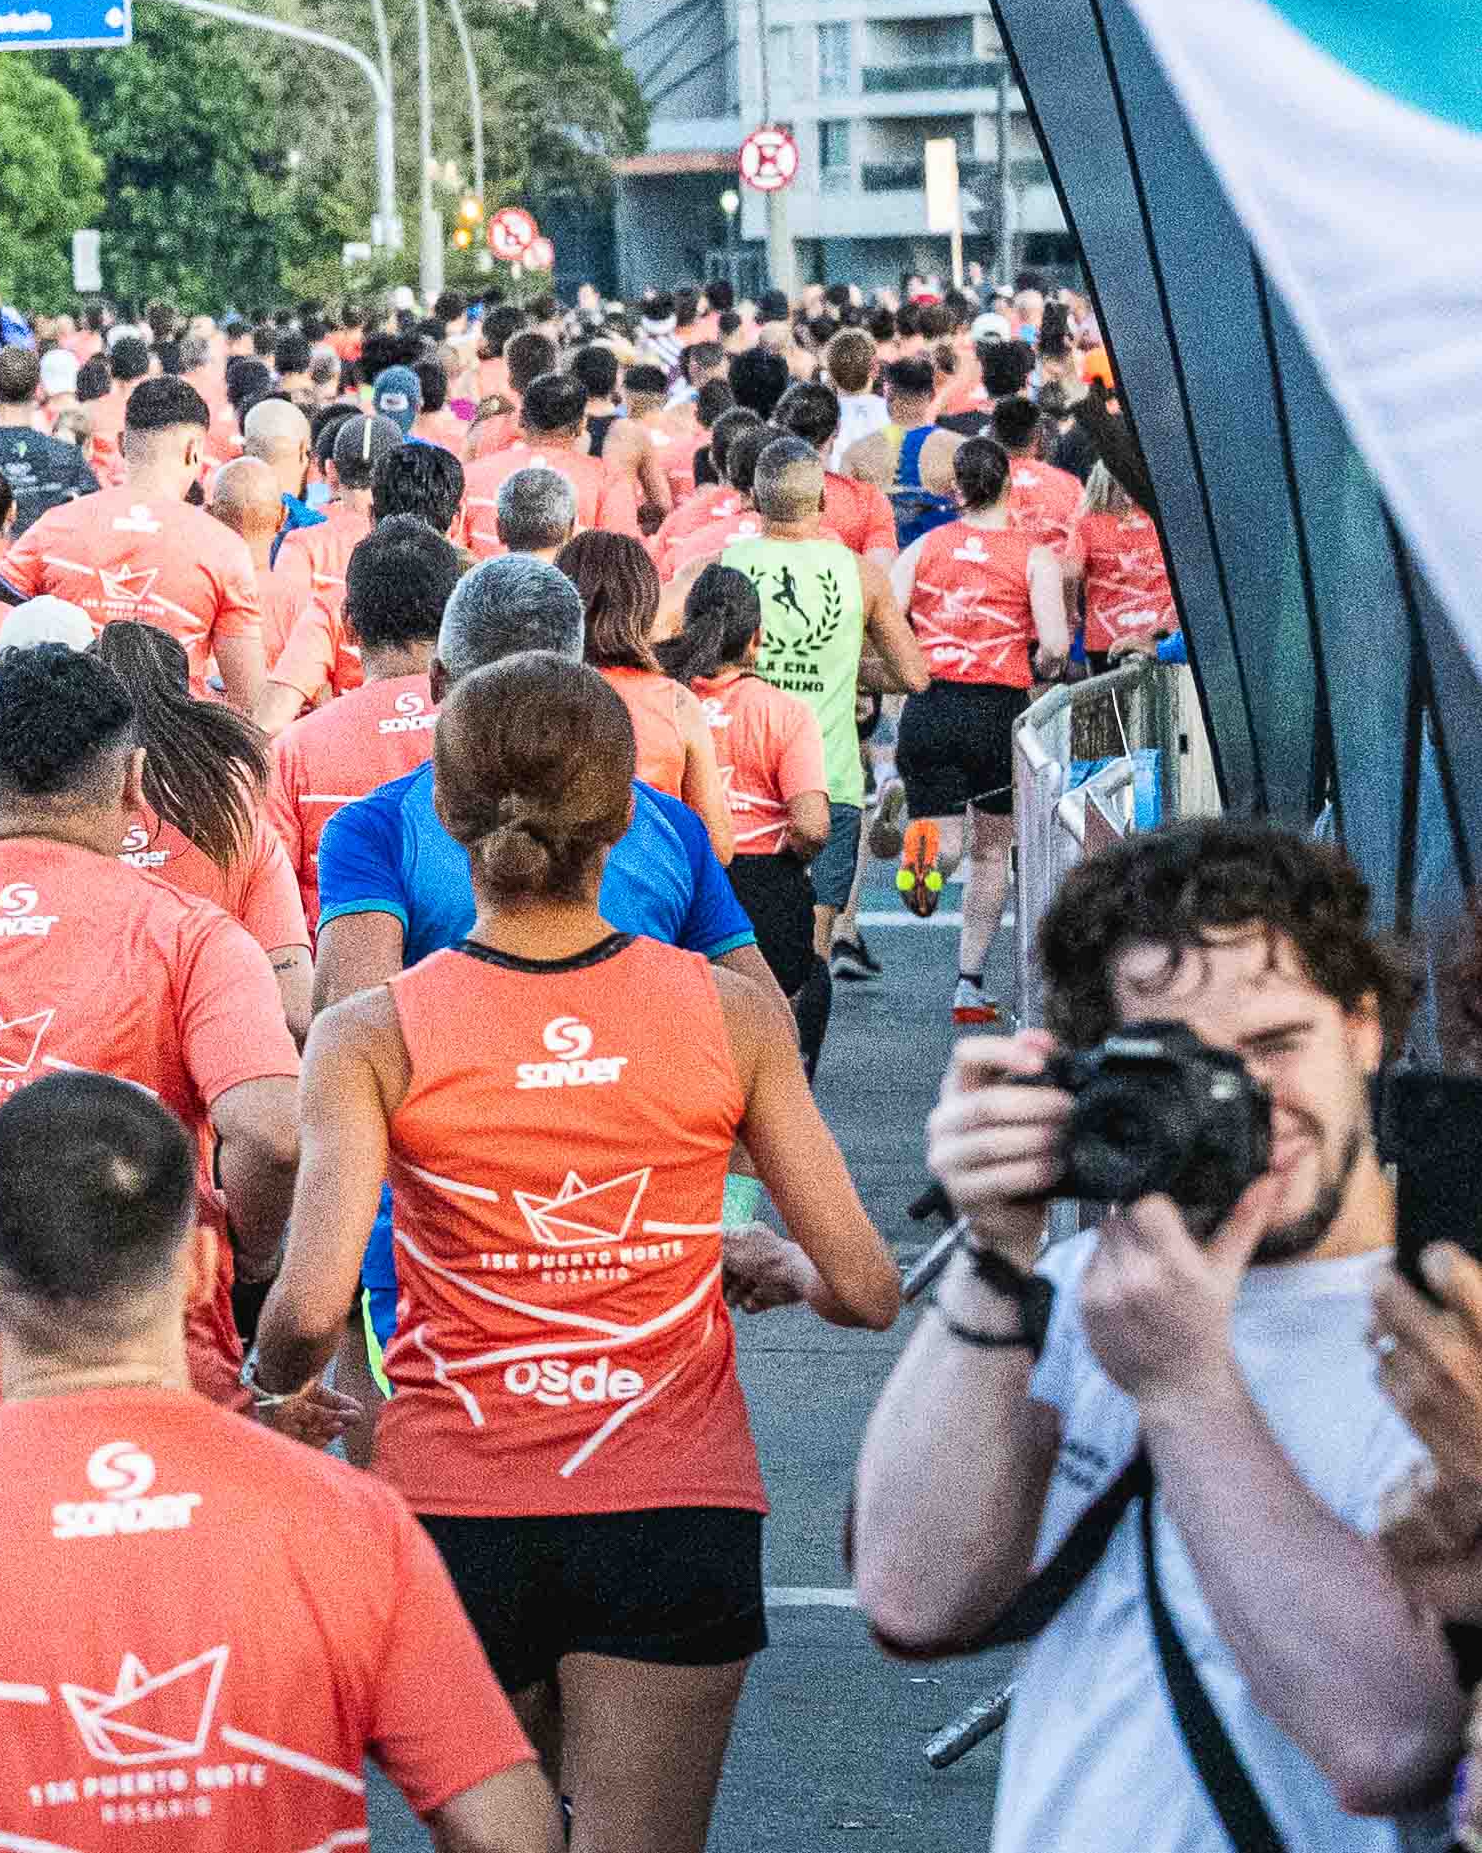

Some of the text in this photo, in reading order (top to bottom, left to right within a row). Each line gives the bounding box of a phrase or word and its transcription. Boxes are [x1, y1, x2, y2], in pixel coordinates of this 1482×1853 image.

[480, 1240, 684, 1269] 15K PUERTO NORTE
[541, 1266, 632, 1284] ROSARIO
[504, 1356, 644, 1406] osde
[82, 1768, 188, 1797] PUERTO
